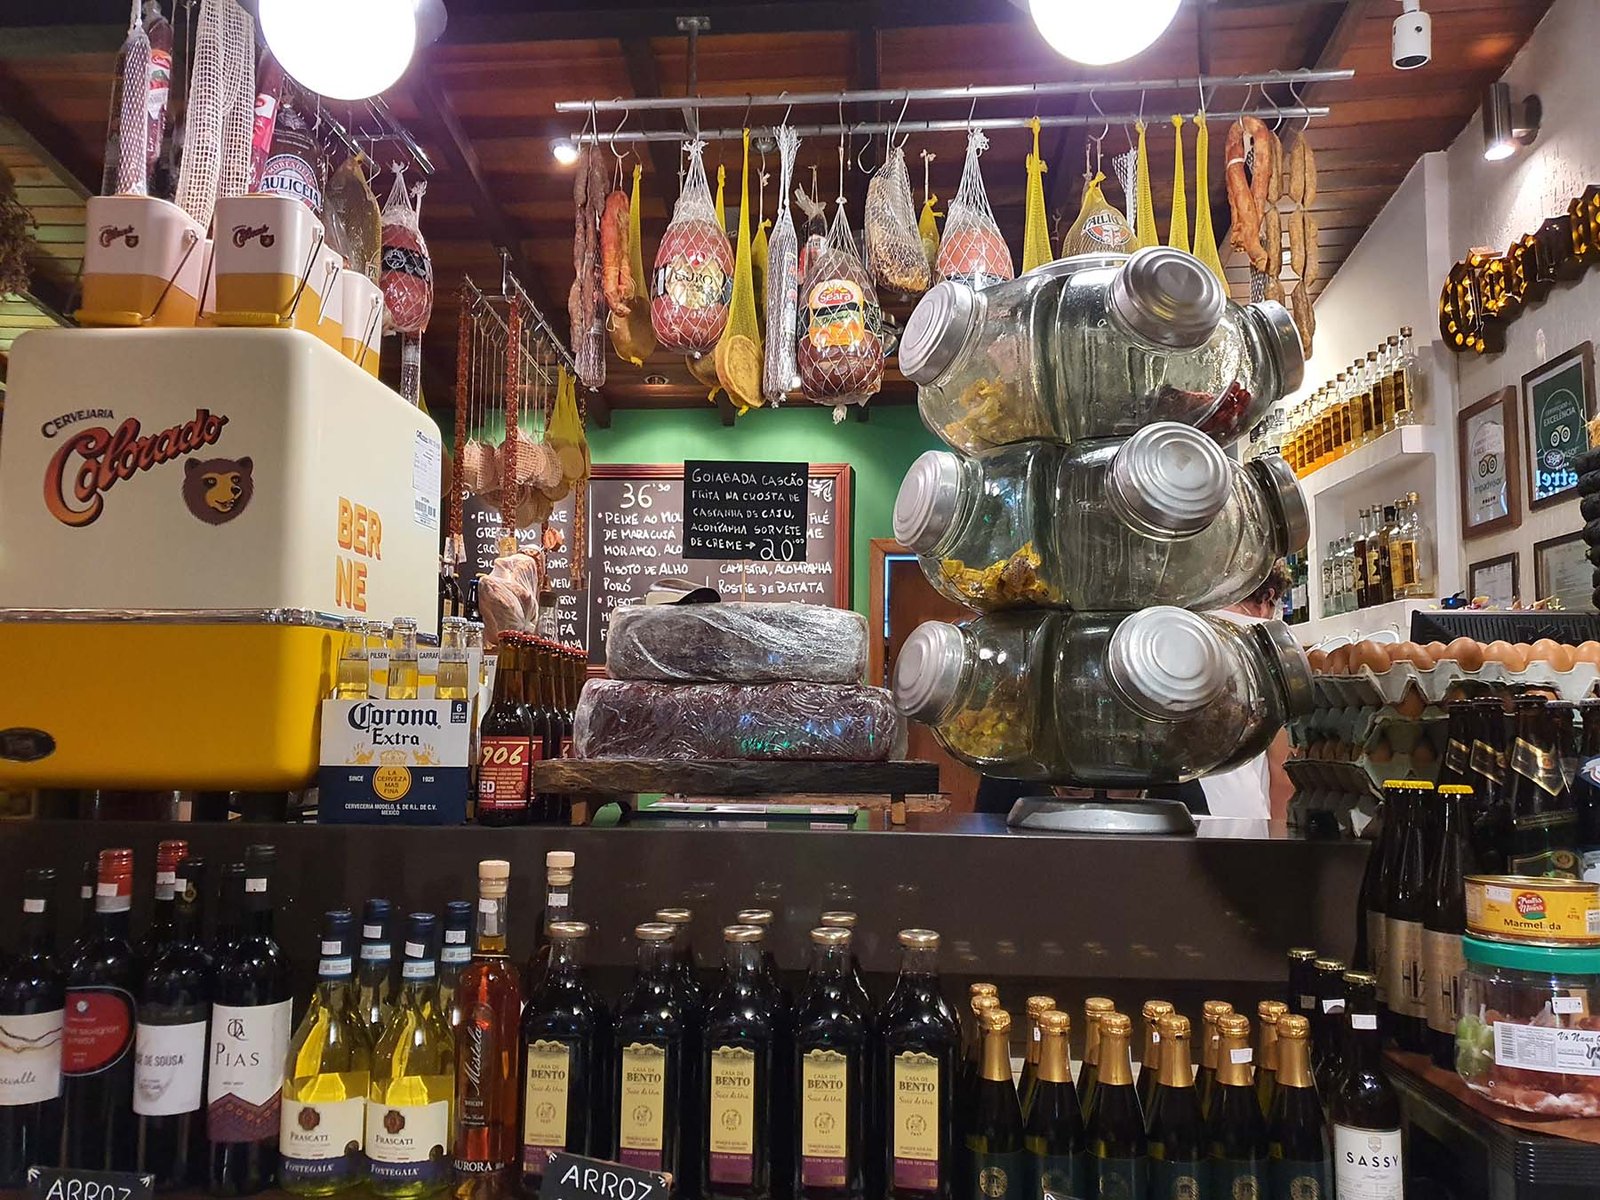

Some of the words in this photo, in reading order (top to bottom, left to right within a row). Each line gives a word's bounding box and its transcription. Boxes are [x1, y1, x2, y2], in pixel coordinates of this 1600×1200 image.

[41, 408, 115, 438] CERVEJARIA
[43, 409, 229, 527] Colorado
[691, 468, 757, 484] GOIABADA
[762, 472, 804, 487] CASCÃO
[692, 489, 720, 501] FRITA
[725, 491, 739, 501] NA
[743, 491, 785, 502] CROSTA
[789, 493, 800, 502] DE
[605, 512, 639, 525] PEIXE
[643, 515, 658, 524] AO
[693, 508, 743, 518] CASTANHA
[337, 496, 382, 560] BER
[691, 521, 747, 535] ACOMPANHA
[754, 524, 801, 536] SORVETE
[603, 529, 618, 541] DE
[690, 537, 702, 546] DE
[706, 538, 742, 551] CREME
[659, 563, 689, 575] ALHO
[774, 562, 832, 575] ACOMPANHA
[335, 555, 367, 612] NE
[760, 584, 774, 595] DE
[775, 582, 824, 594] BATATA
[456, 704, 463, 712] 6
[348, 703, 439, 733] Corona
[371, 727, 420, 746] Extra
[482, 745, 524, 766] 906
[1503, 918, 1561, 931] Marmelda
[154, 1055, 184, 1067] SOUSA
[214, 1043, 260, 1067] PIAS
[531, 1069, 566, 1080] BENTO
[626, 1072, 661, 1083] BENTO
[715, 1076, 750, 1087] BENTO
[807, 1079, 843, 1090] BENTO
[899, 1081, 935, 1092] BENTO
[290, 1132, 328, 1142] FRASCATI
[375, 1135, 414, 1145] FRASCATI
[454, 1160, 493, 1172] AURORA
[1346, 1152, 1398, 1168] SASSY
[561, 1165, 652, 1200] ARROZ
